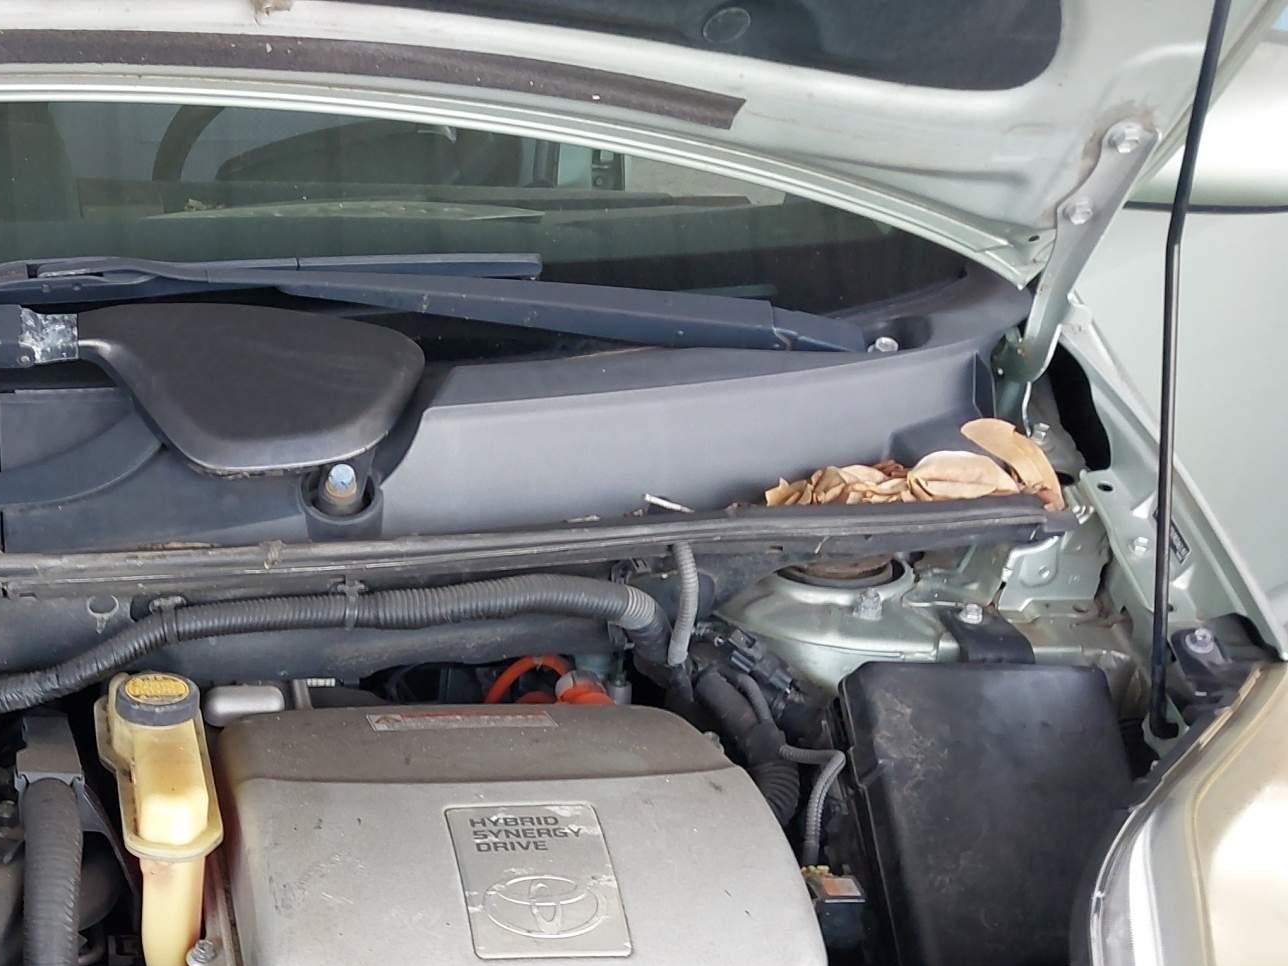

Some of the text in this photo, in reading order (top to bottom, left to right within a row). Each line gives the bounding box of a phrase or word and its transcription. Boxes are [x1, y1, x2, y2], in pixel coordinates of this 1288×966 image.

[469, 815, 559, 828] HYBRID
[472, 827, 583, 840] SYNERGY
[475, 840, 549, 853] DRIVE
